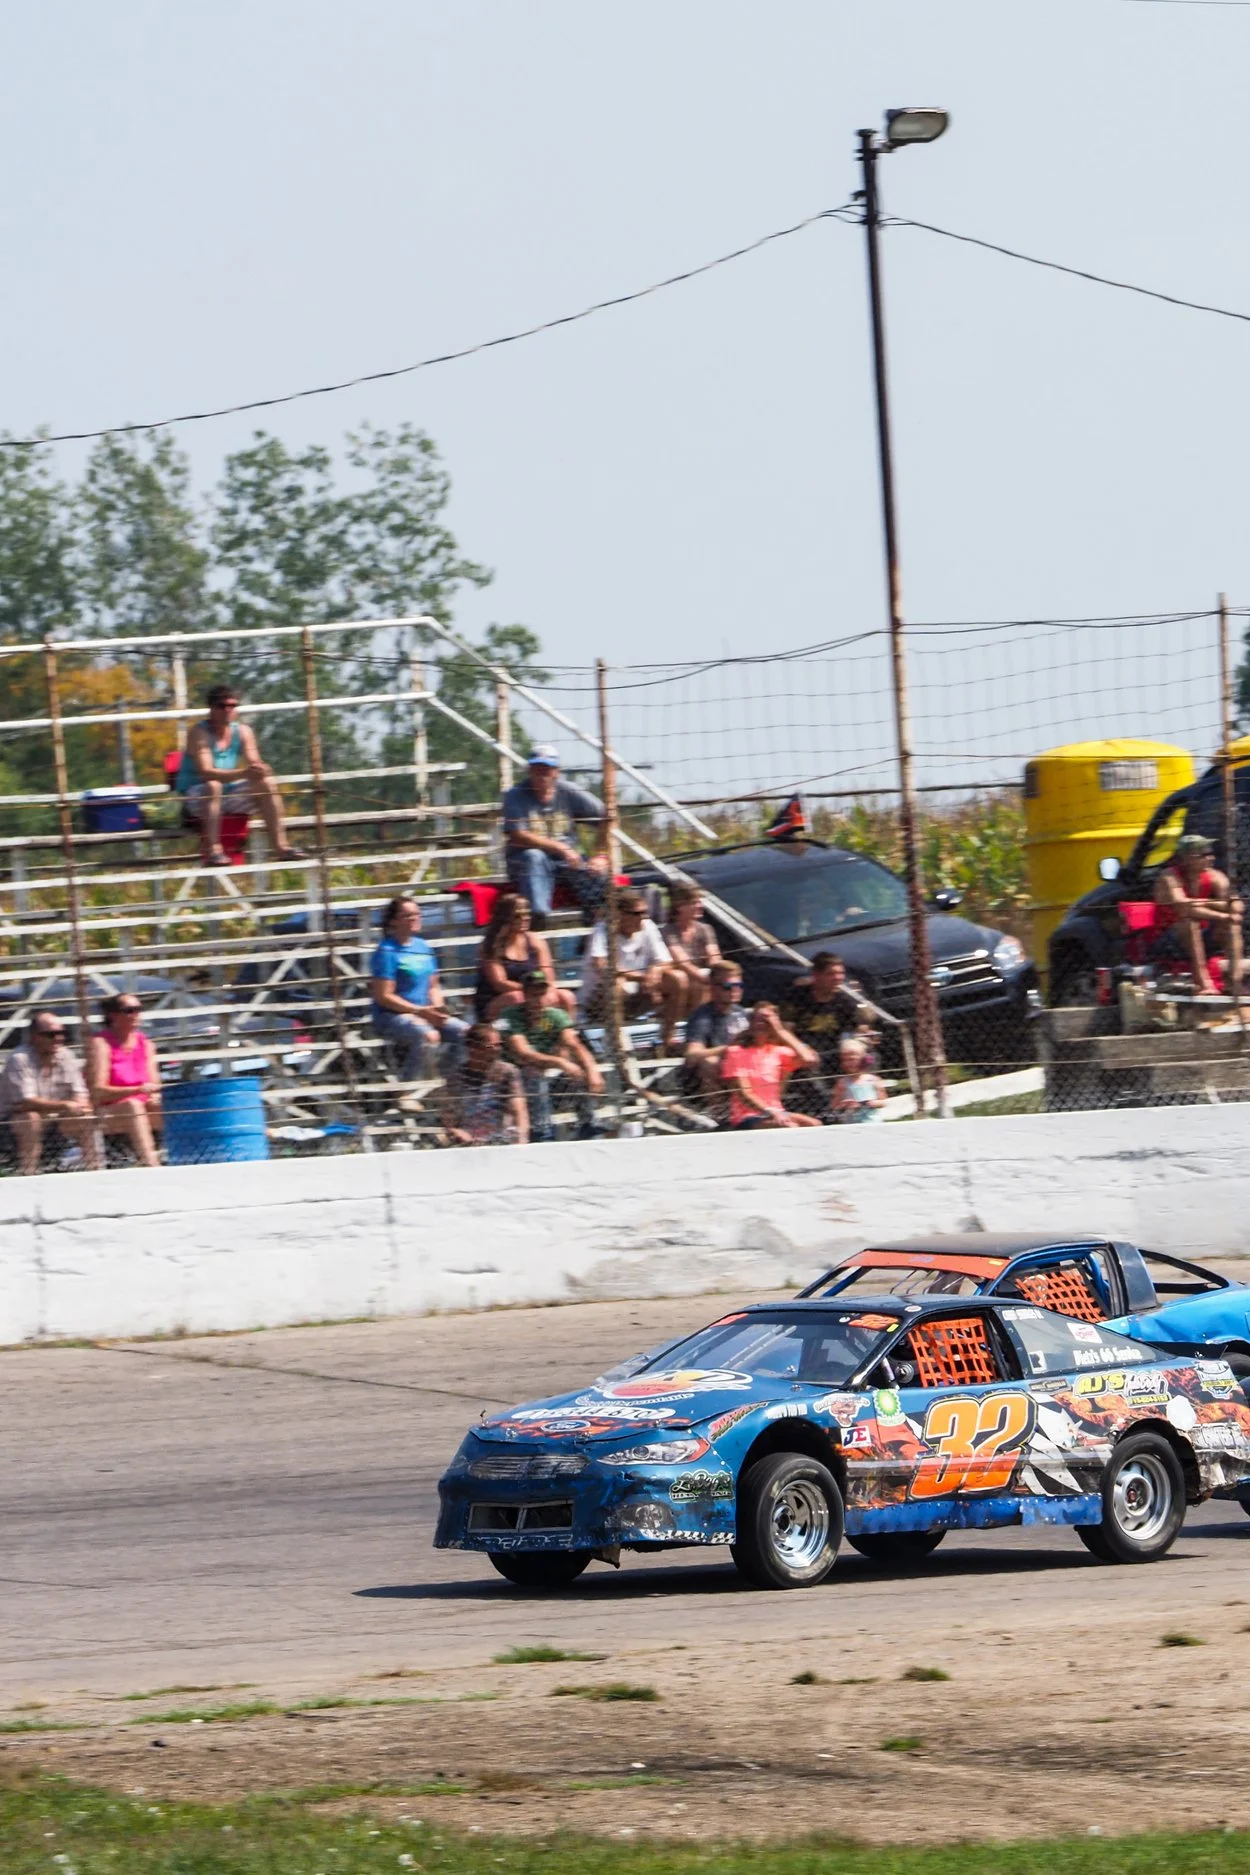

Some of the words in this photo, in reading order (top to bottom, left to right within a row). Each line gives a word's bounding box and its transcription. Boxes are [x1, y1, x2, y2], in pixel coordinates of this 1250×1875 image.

[1078, 1372, 1127, 1393] AJ'S
[843, 1427, 868, 1447] JE
[909, 1391, 1038, 1499] 32
